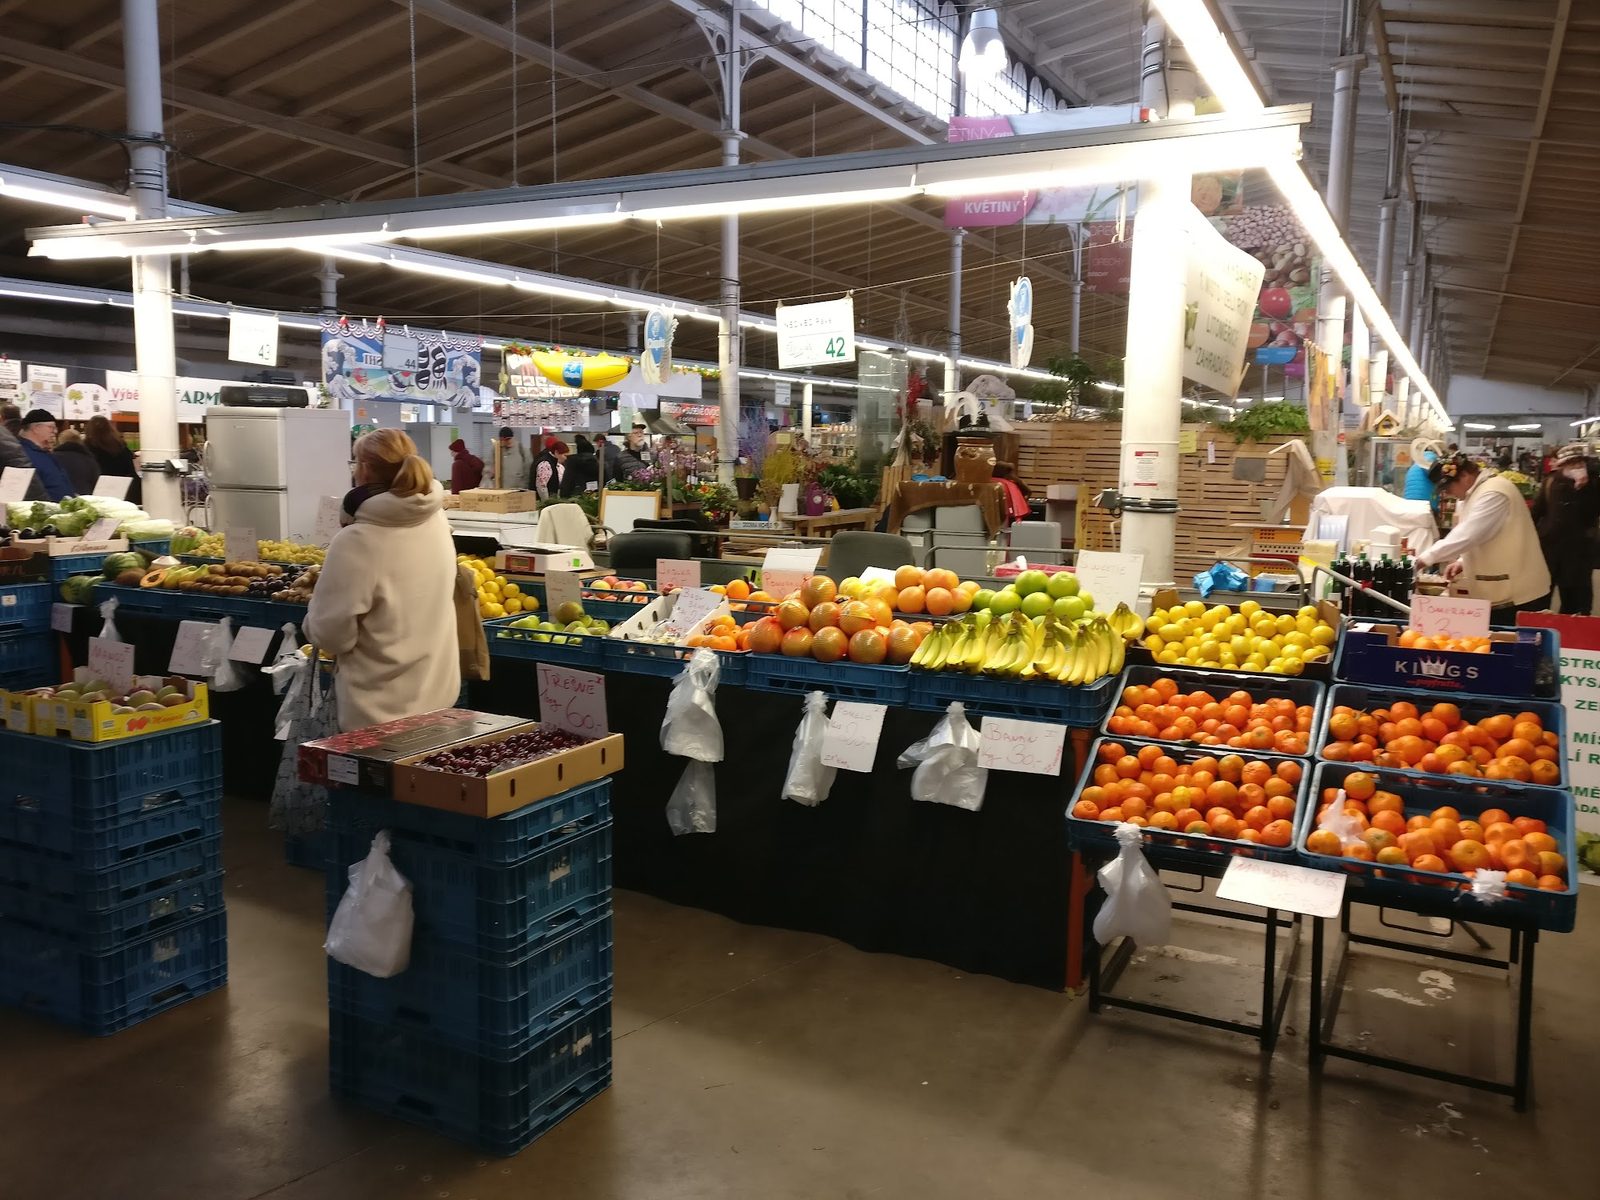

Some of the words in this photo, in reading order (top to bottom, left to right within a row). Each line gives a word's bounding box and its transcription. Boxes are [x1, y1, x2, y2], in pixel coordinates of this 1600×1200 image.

[964, 200, 1021, 215] KVĚTINY
[825, 336, 846, 358] 42
[404, 358, 417, 369] 44
[1559, 674, 1600, 688] KYS
[1573, 699, 1600, 711] ZE
[1572, 731, 1600, 746] MÍ
